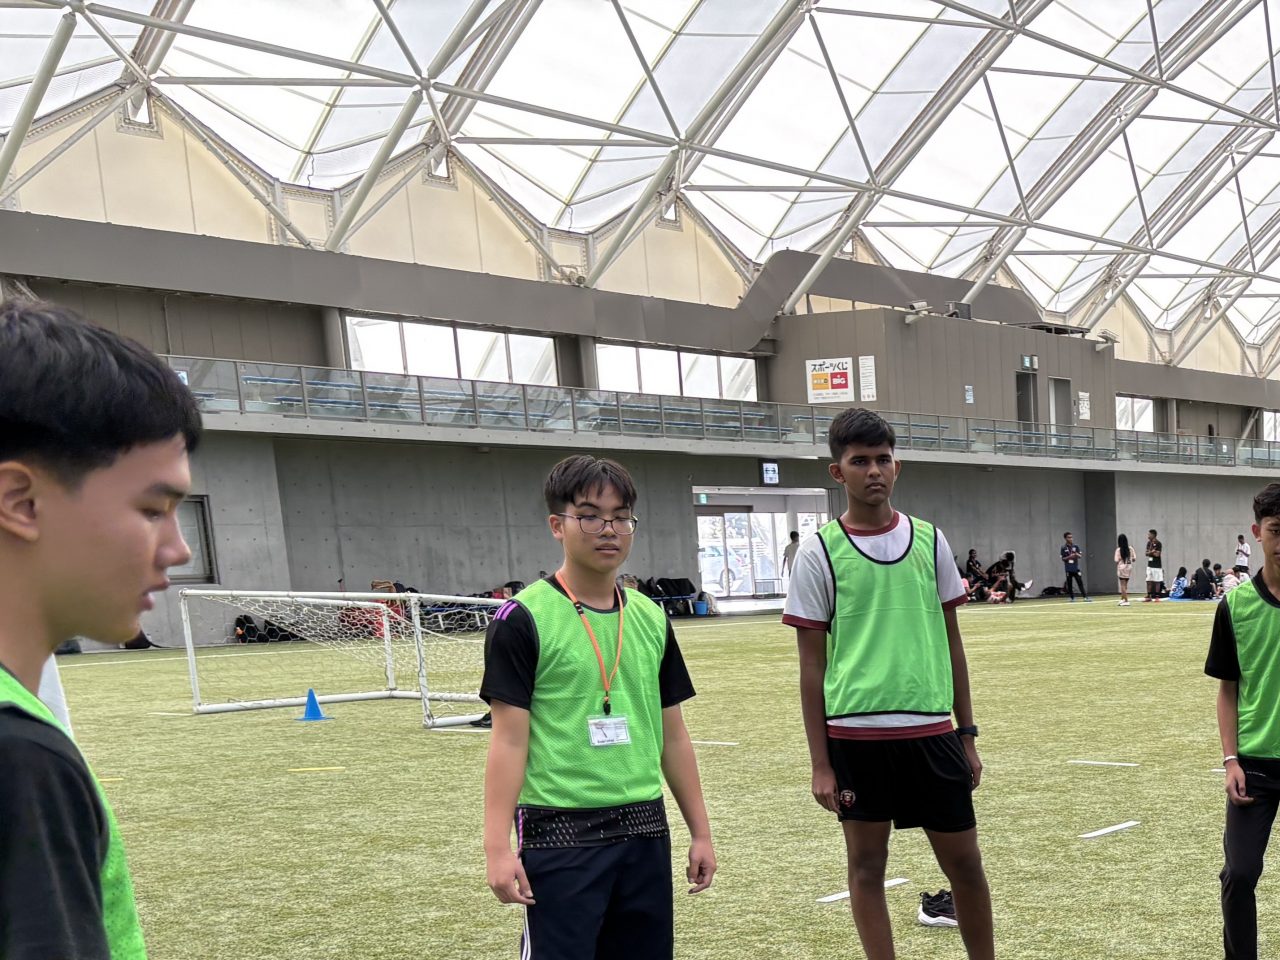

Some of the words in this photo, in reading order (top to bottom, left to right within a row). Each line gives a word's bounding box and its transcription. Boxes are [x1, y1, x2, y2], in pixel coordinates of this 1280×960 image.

[811, 361, 848, 372] スポーツくじ
[832, 375, 846, 384] BIG
